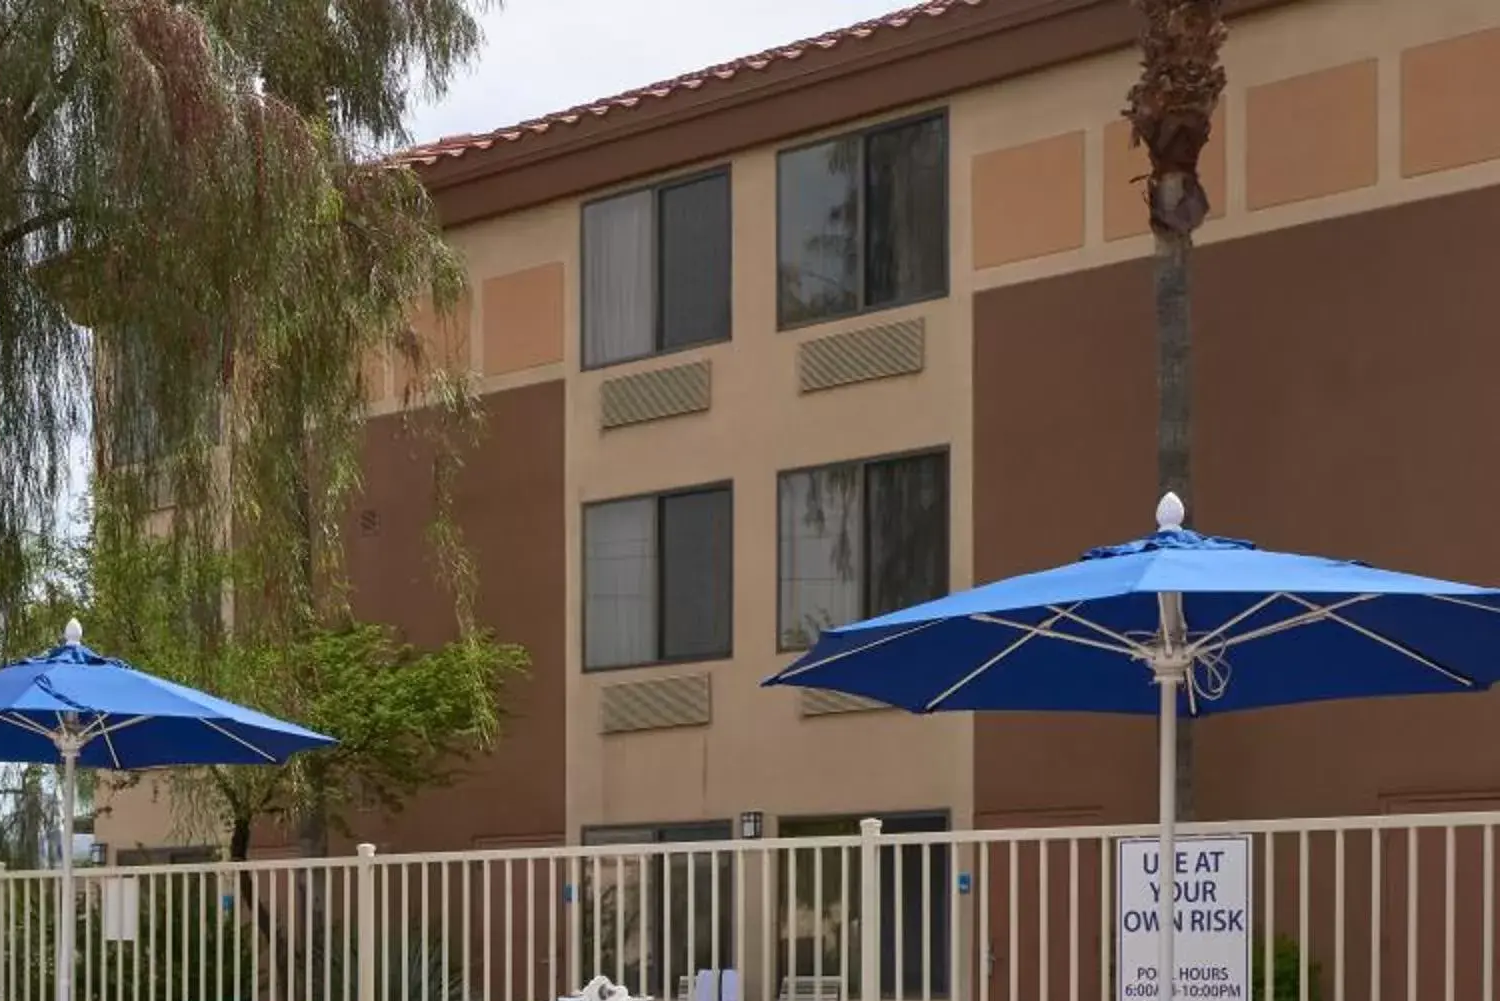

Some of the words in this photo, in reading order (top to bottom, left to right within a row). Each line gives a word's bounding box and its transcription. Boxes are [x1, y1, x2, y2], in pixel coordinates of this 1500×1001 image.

[1143, 851, 1188, 875] UE
[1195, 851, 1224, 873] AT
[1191, 909, 1243, 932] RISK
[1179, 967, 1229, 981] HOURS
